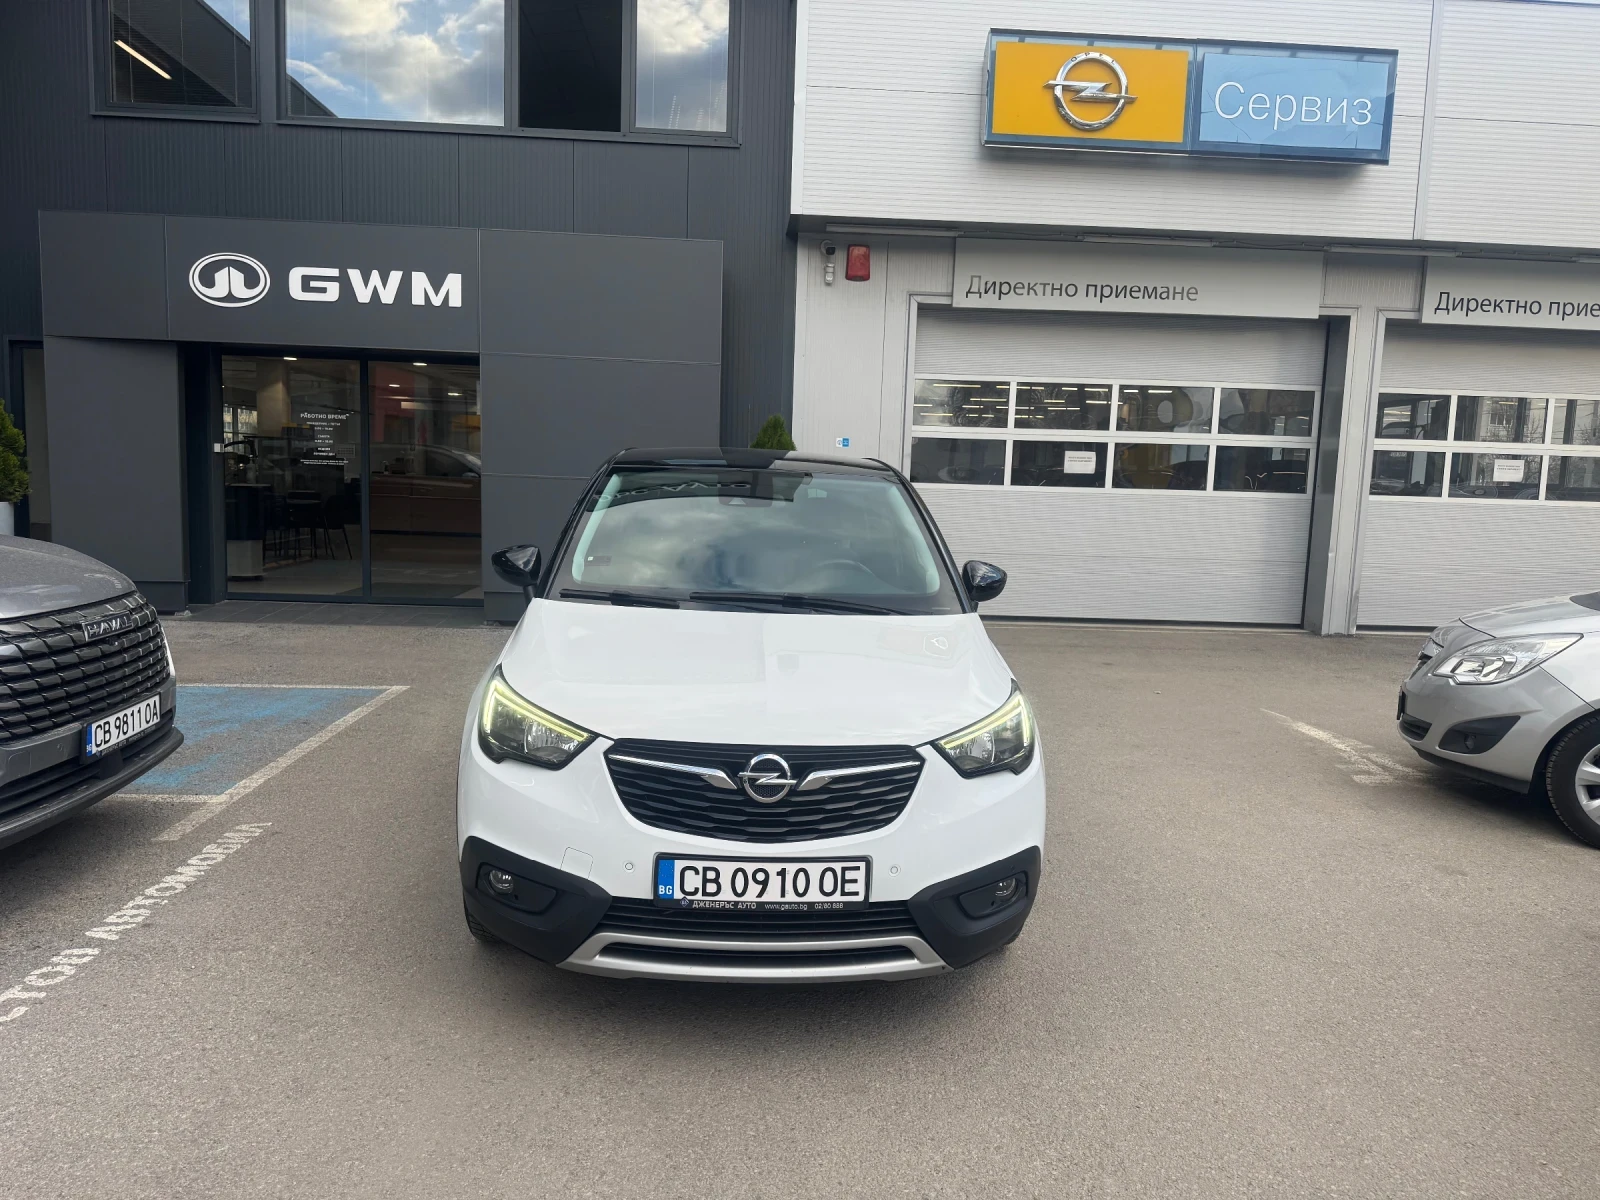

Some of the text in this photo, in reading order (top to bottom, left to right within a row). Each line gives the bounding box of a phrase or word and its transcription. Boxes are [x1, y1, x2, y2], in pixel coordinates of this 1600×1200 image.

[1213, 80, 1373, 131] Сервиз
[288, 266, 463, 308] GWM
[966, 274, 1199, 303] Директно приемане
[1434, 291, 1600, 321] Директно прие
[87, 616, 133, 638] HAVAL
[94, 720, 112, 748] CB
[114, 706, 142, 740] 9811
[658, 885, 673, 895] BG
[679, 865, 861, 899] CB 0910 OE
[692, 900, 735, 909] ДЖЕНЕРЪС
[737, 901, 757, 909] АУТО
[764, 902, 808, 911] www.gauto.bg
